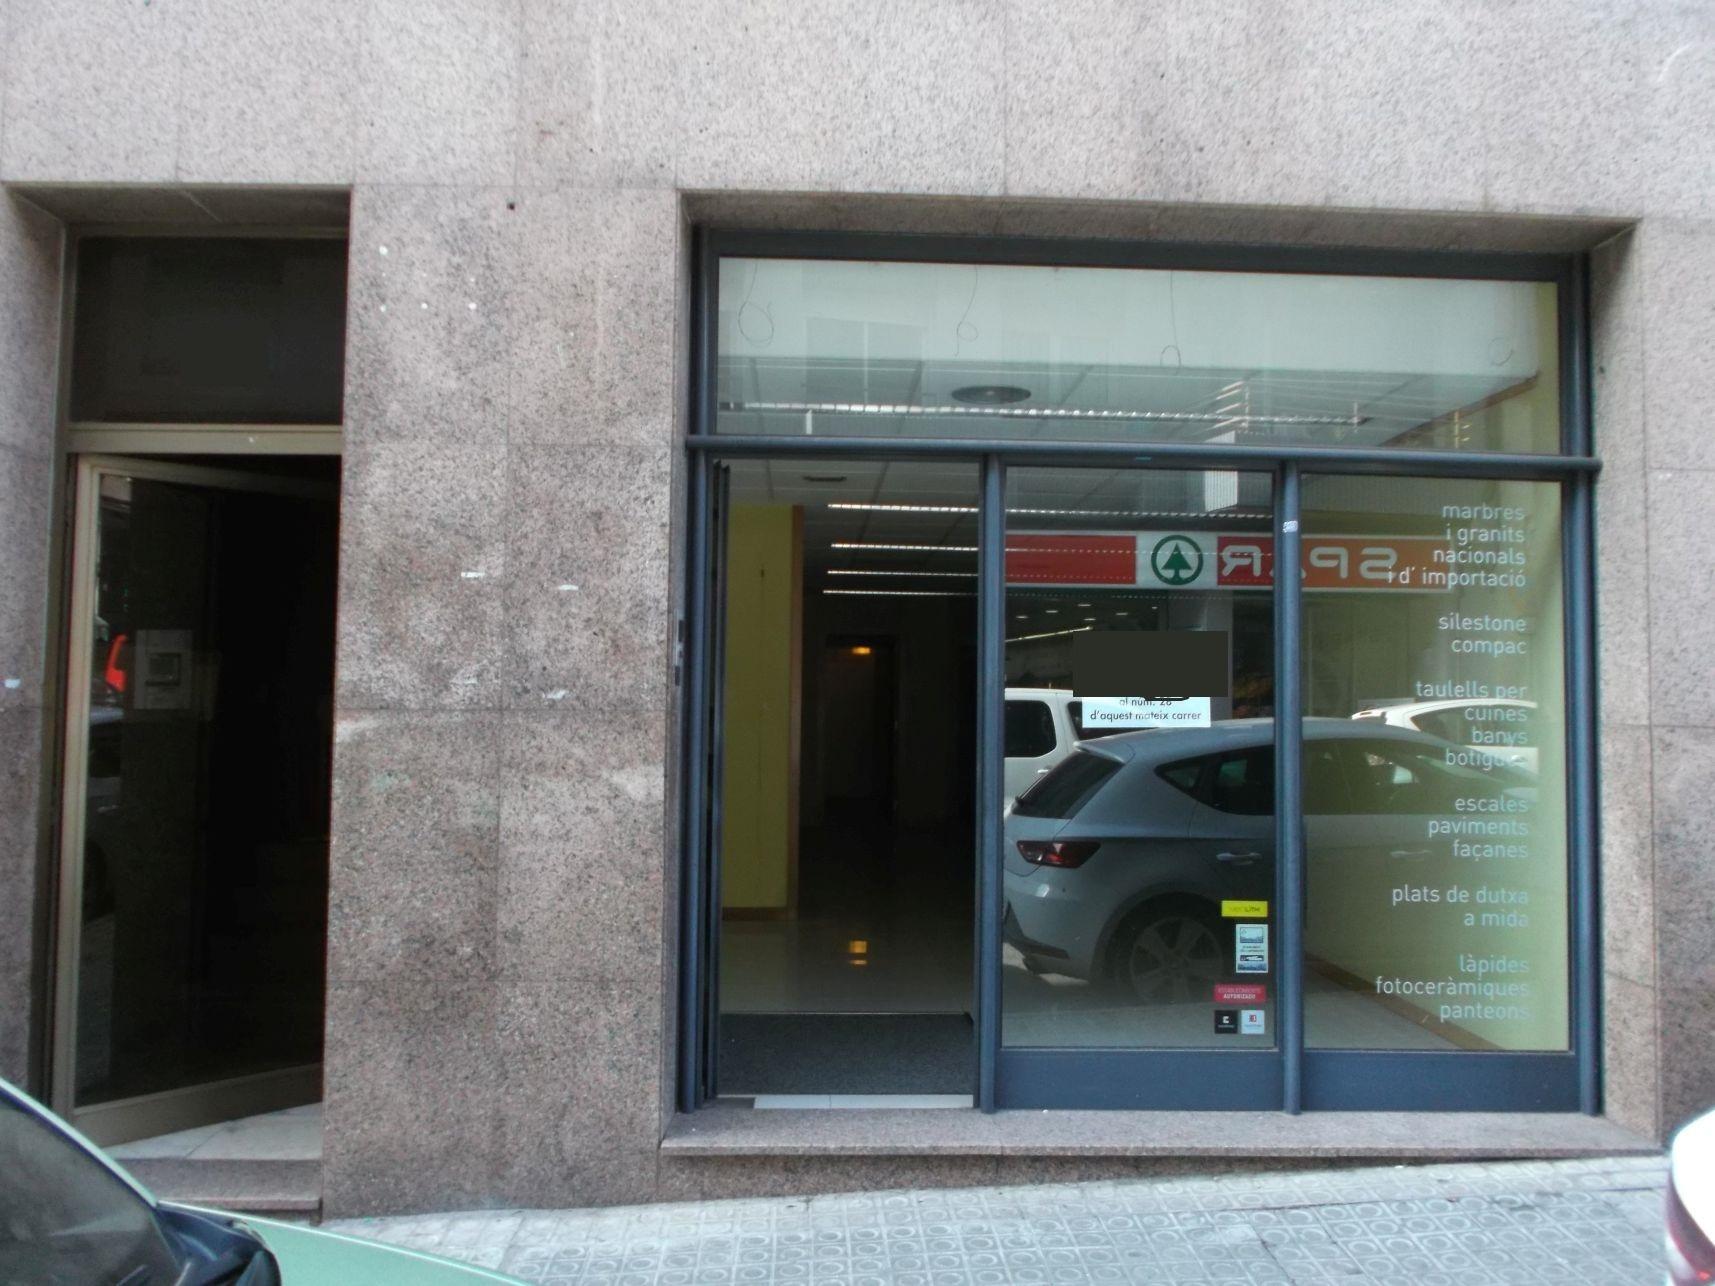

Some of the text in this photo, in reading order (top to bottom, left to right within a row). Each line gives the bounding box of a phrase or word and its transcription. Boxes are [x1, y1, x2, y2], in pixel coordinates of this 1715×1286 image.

[1442, 503, 1525, 520] marbres
[1445, 524, 1525, 546] i granits
[1433, 546, 1526, 565] nacionals
[1387, 565, 1393, 583] i
[1422, 567, 1526, 589] importació
[1438, 612, 1527, 632] silestone
[1451, 639, 1527, 657] compac
[1415, 680, 1528, 701] taulells per
[1090, 710, 1202, 723] d'aquest mateix carrer
[1464, 705, 1528, 722] cuines
[1472, 726, 1528, 747] banys
[1455, 795, 1528, 813] escales
[1428, 816, 1528, 837] paviments
[1453, 839, 1528, 861] façanes
[1392, 884, 1529, 906] plats de dutxa
[1464, 909, 1529, 927] a mida
[1459, 954, 1529, 975] làpides
[1376, 976, 1529, 1000] fotoceràmiques
[1440, 1003, 1529, 1023] panteons
